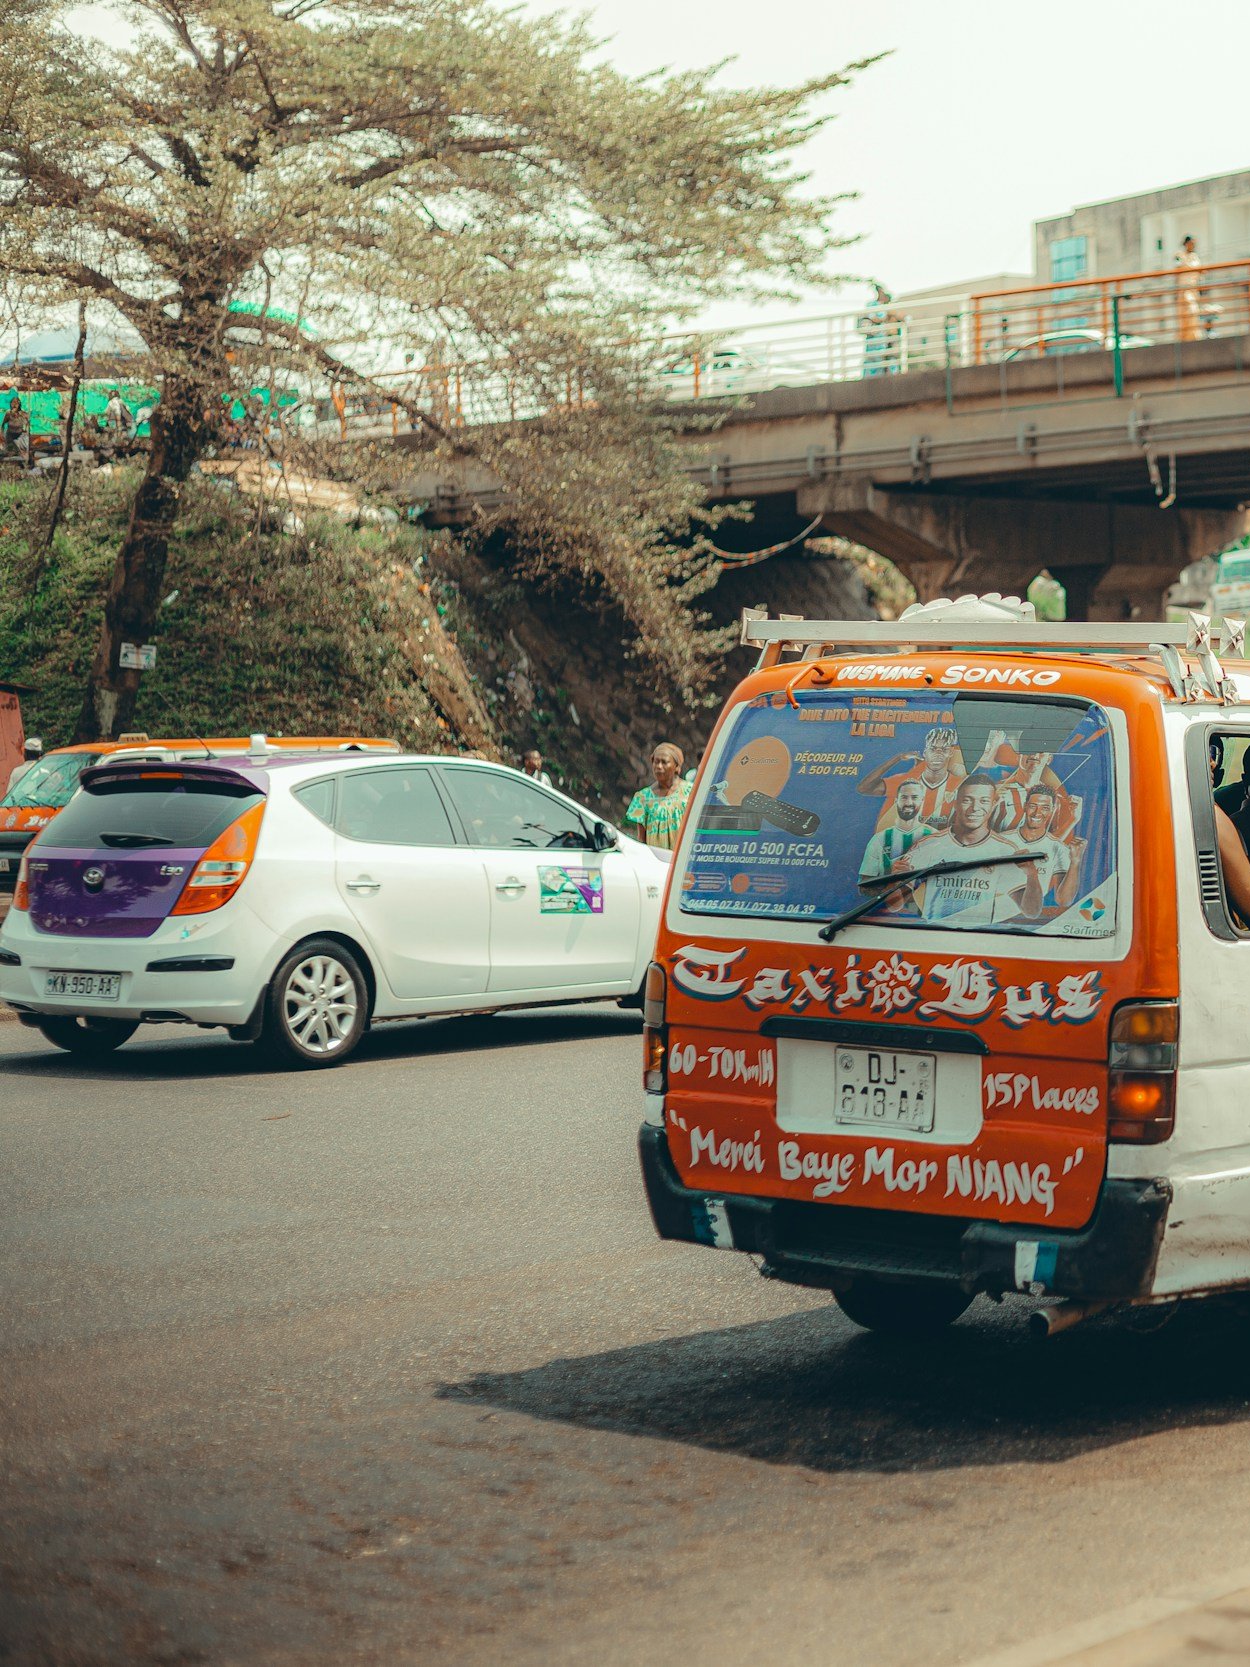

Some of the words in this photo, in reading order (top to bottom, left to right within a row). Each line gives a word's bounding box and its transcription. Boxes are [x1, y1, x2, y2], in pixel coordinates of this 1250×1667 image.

[837, 664, 926, 682] OUSMANE
[940, 665, 1061, 687] SONKO
[852, 708, 870, 721] THE
[850, 722, 866, 737] LA
[794, 750, 847, 764] DÉCODEUR
[849, 752, 863, 764] HD
[809, 765, 831, 776] 500
[832, 765, 858, 777] FCFA
[713, 843, 740, 854] POUR
[742, 841, 757, 855] 10
[759, 841, 785, 856] 500
[787, 843, 824, 857] FCFA
[725, 855, 758, 864] BOUQUET
[758, 856, 780, 865] SUPER
[805, 859, 829, 868] FCFA)
[160, 864, 184, 876] i30
[935, 874, 990, 890] Emirates
[953, 889, 982, 901] BETTER
[1062, 924, 1117, 937] StarTimes
[672, 943, 867, 1009] Taxi
[919, 957, 1101, 1025] Bus
[777, 1140, 856, 1200] Baye
[862, 1145, 938, 1195] Mor
